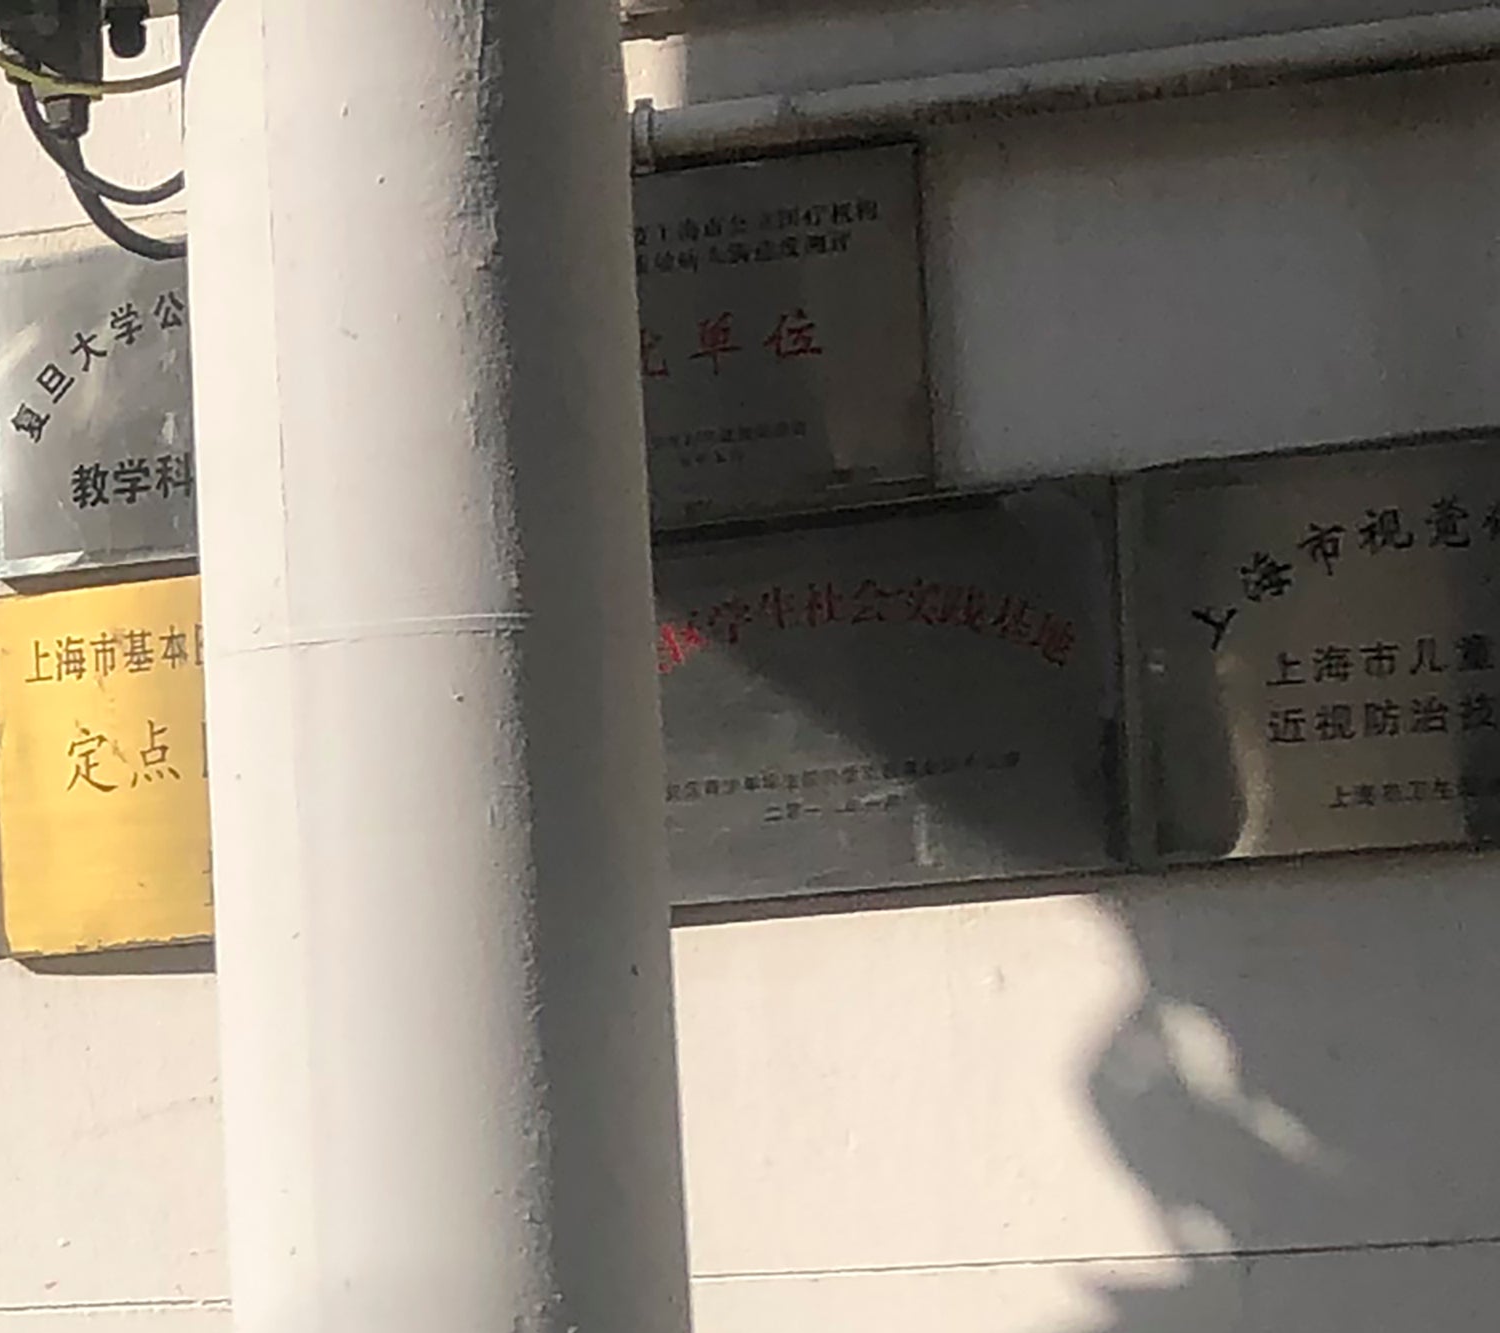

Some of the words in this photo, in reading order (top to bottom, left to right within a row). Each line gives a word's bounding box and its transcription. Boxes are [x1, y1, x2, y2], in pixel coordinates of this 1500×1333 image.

[11, 290, 186, 444] 复旦大学公
[71, 453, 194, 509] 教学科
[1265, 632, 1497, 687] 上海市儿童
[66, 719, 209, 793] 定点
